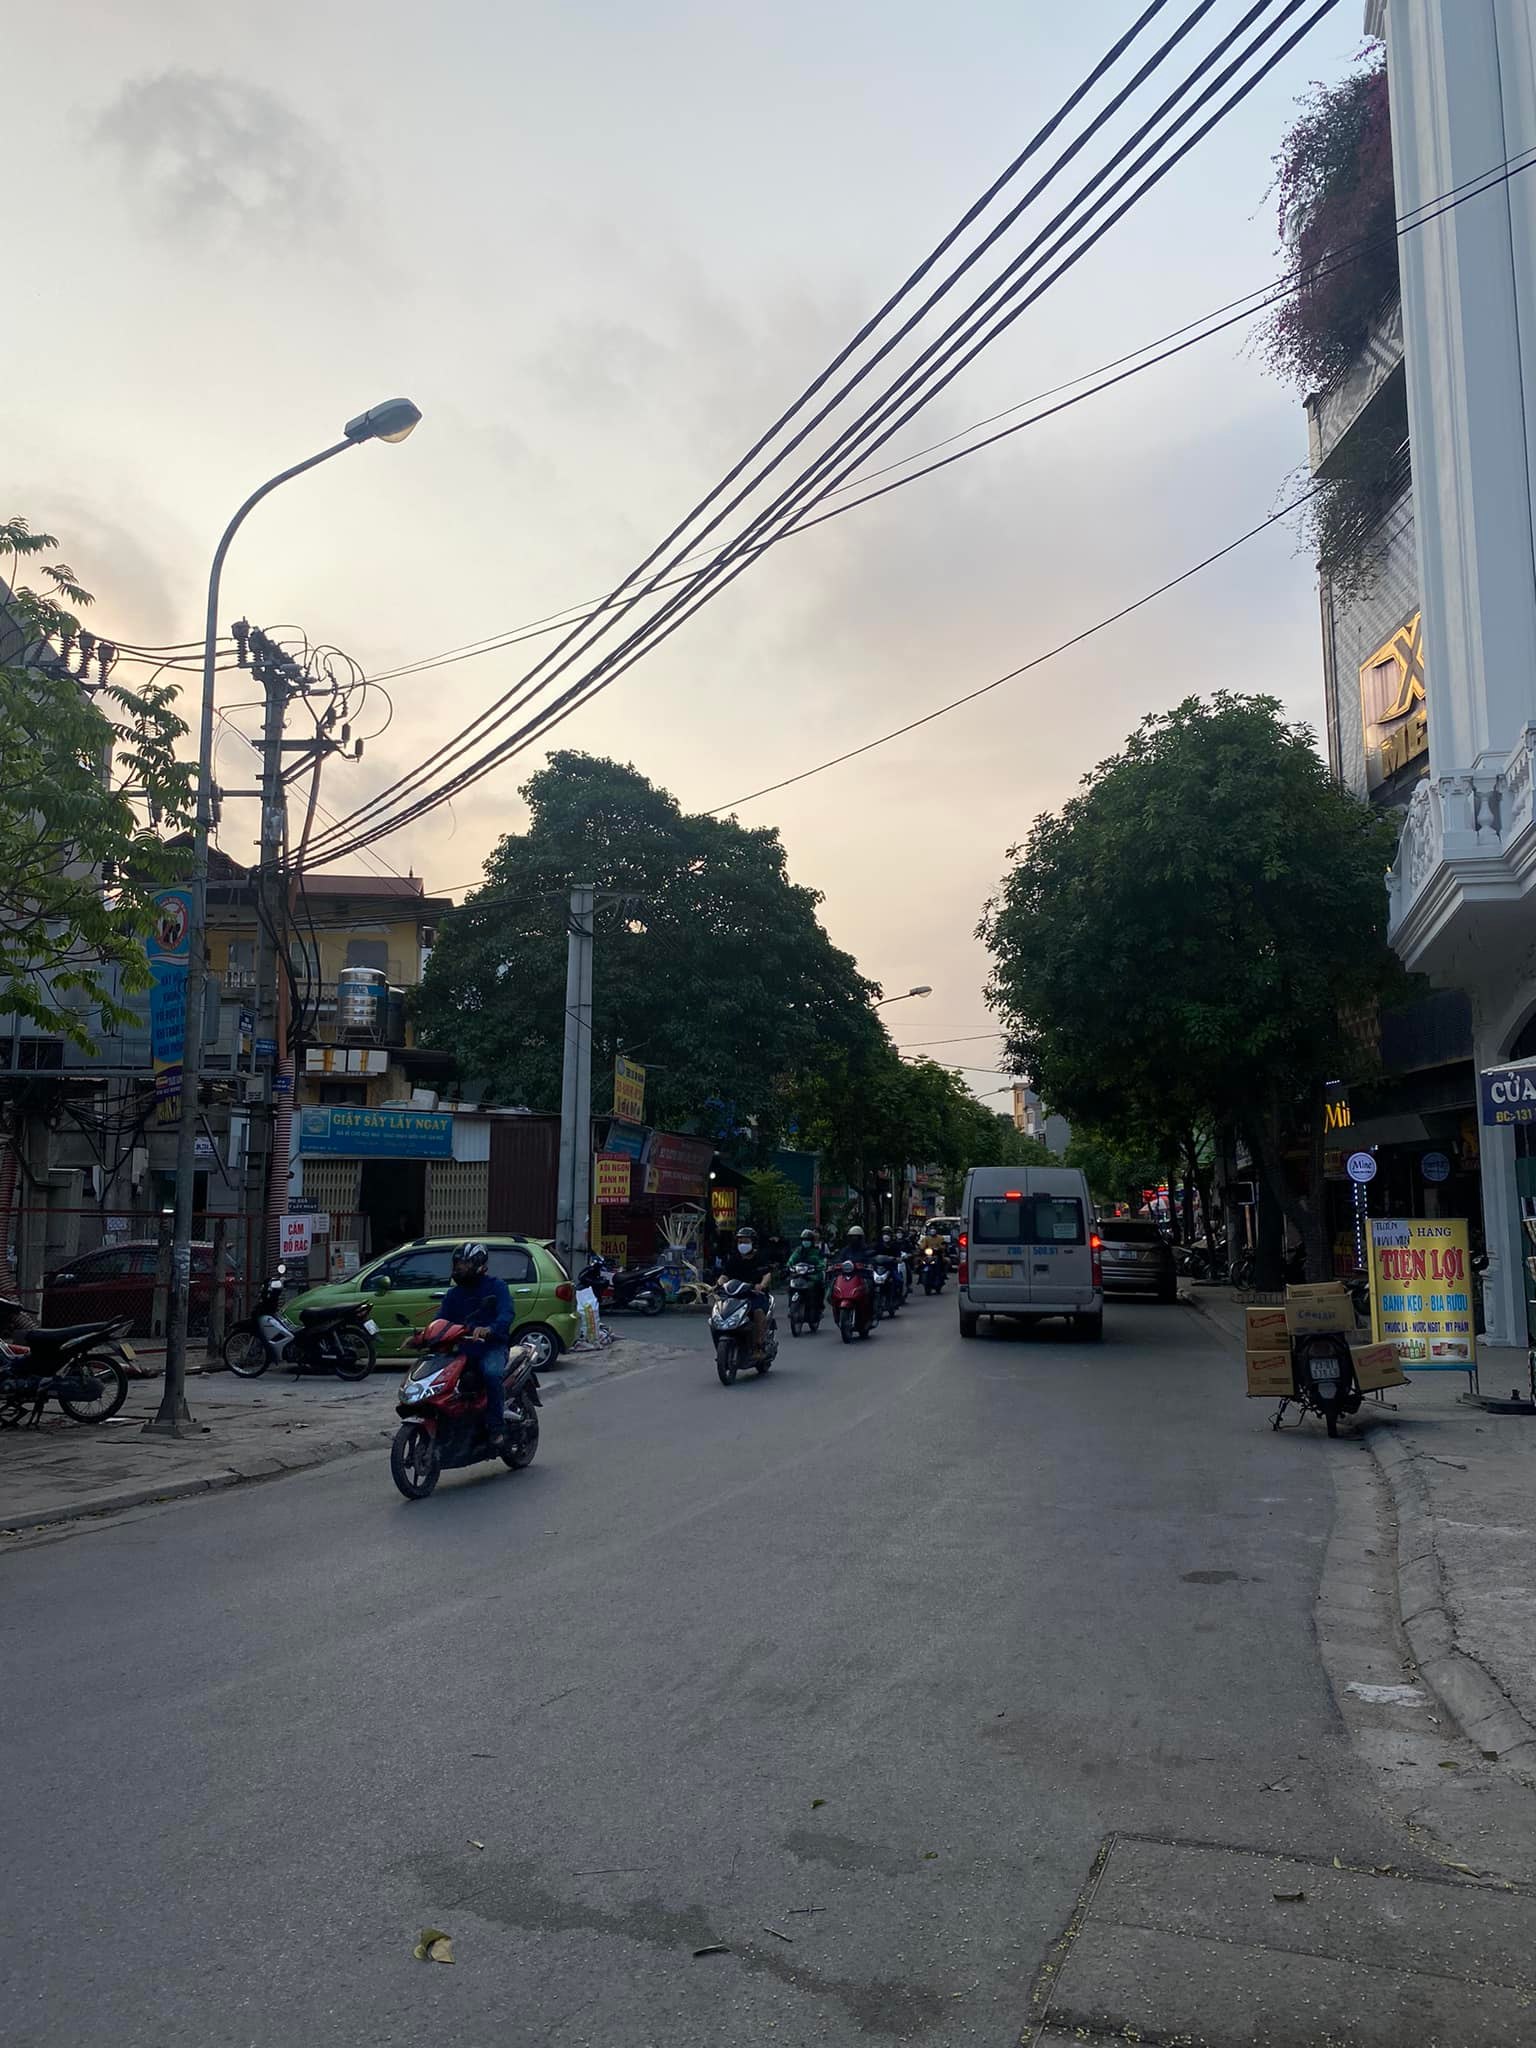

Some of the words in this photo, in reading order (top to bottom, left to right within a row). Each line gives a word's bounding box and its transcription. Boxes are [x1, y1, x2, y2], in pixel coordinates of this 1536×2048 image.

[415, 1118, 449, 1131] NGAY
[1380, 1247, 1426, 1288] TIỆN
[1430, 1247, 1464, 1288] LỢI
[1430, 1294, 1445, 1312] BIA
